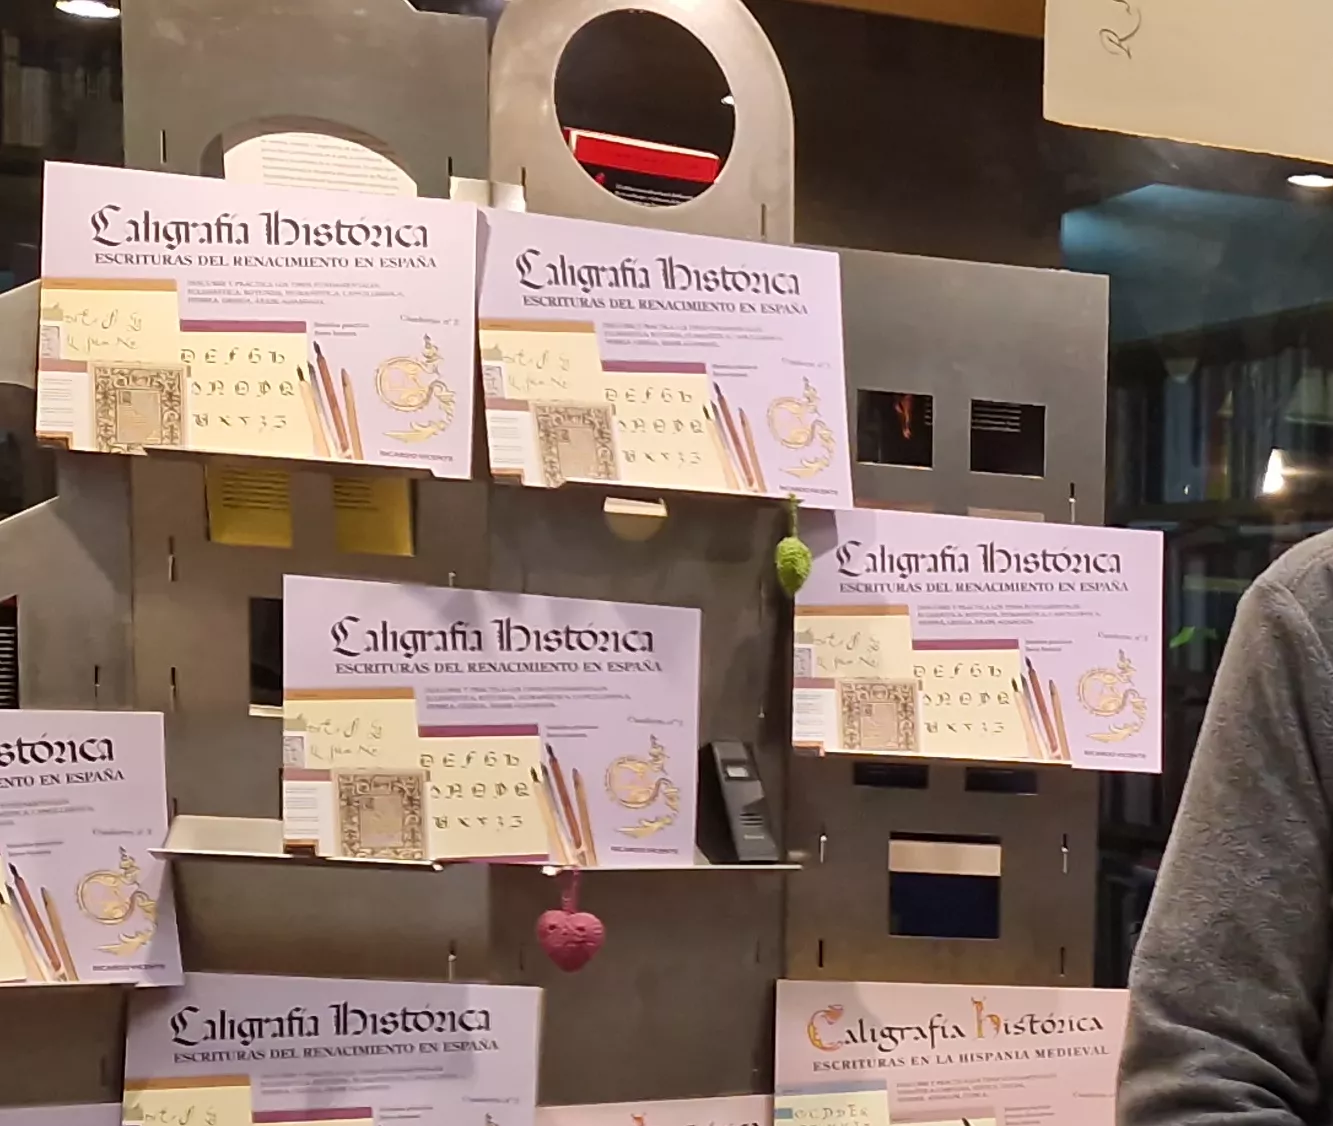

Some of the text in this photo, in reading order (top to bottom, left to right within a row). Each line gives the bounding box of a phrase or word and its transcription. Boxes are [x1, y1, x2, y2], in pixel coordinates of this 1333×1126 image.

[94, 253, 437, 268] ESCRITURAS DEL RENACIMIENTO EN ESPAÑA
[523, 295, 808, 315] ESCRITURAS DEL RENACIMIENTO EN ESPAÑA
[840, 579, 1128, 593] ESCRITURAS DEL RENACIMIENTO EN ESPAÑA
[335, 658, 662, 674] ESCRITURAS DEL RENACIMIENTO EN ESPAÑA
[40, 769, 124, 786] EN ESPAÑA
[807, 1004, 966, 1053] Caligrafía
[174, 1038, 499, 1064] ESCRITURAS DEL RENACIMIENTO EN ESPAÑA
[813, 1045, 1109, 1073] ESCRITURAS EN LA HISPANIA MEDIEVAL
